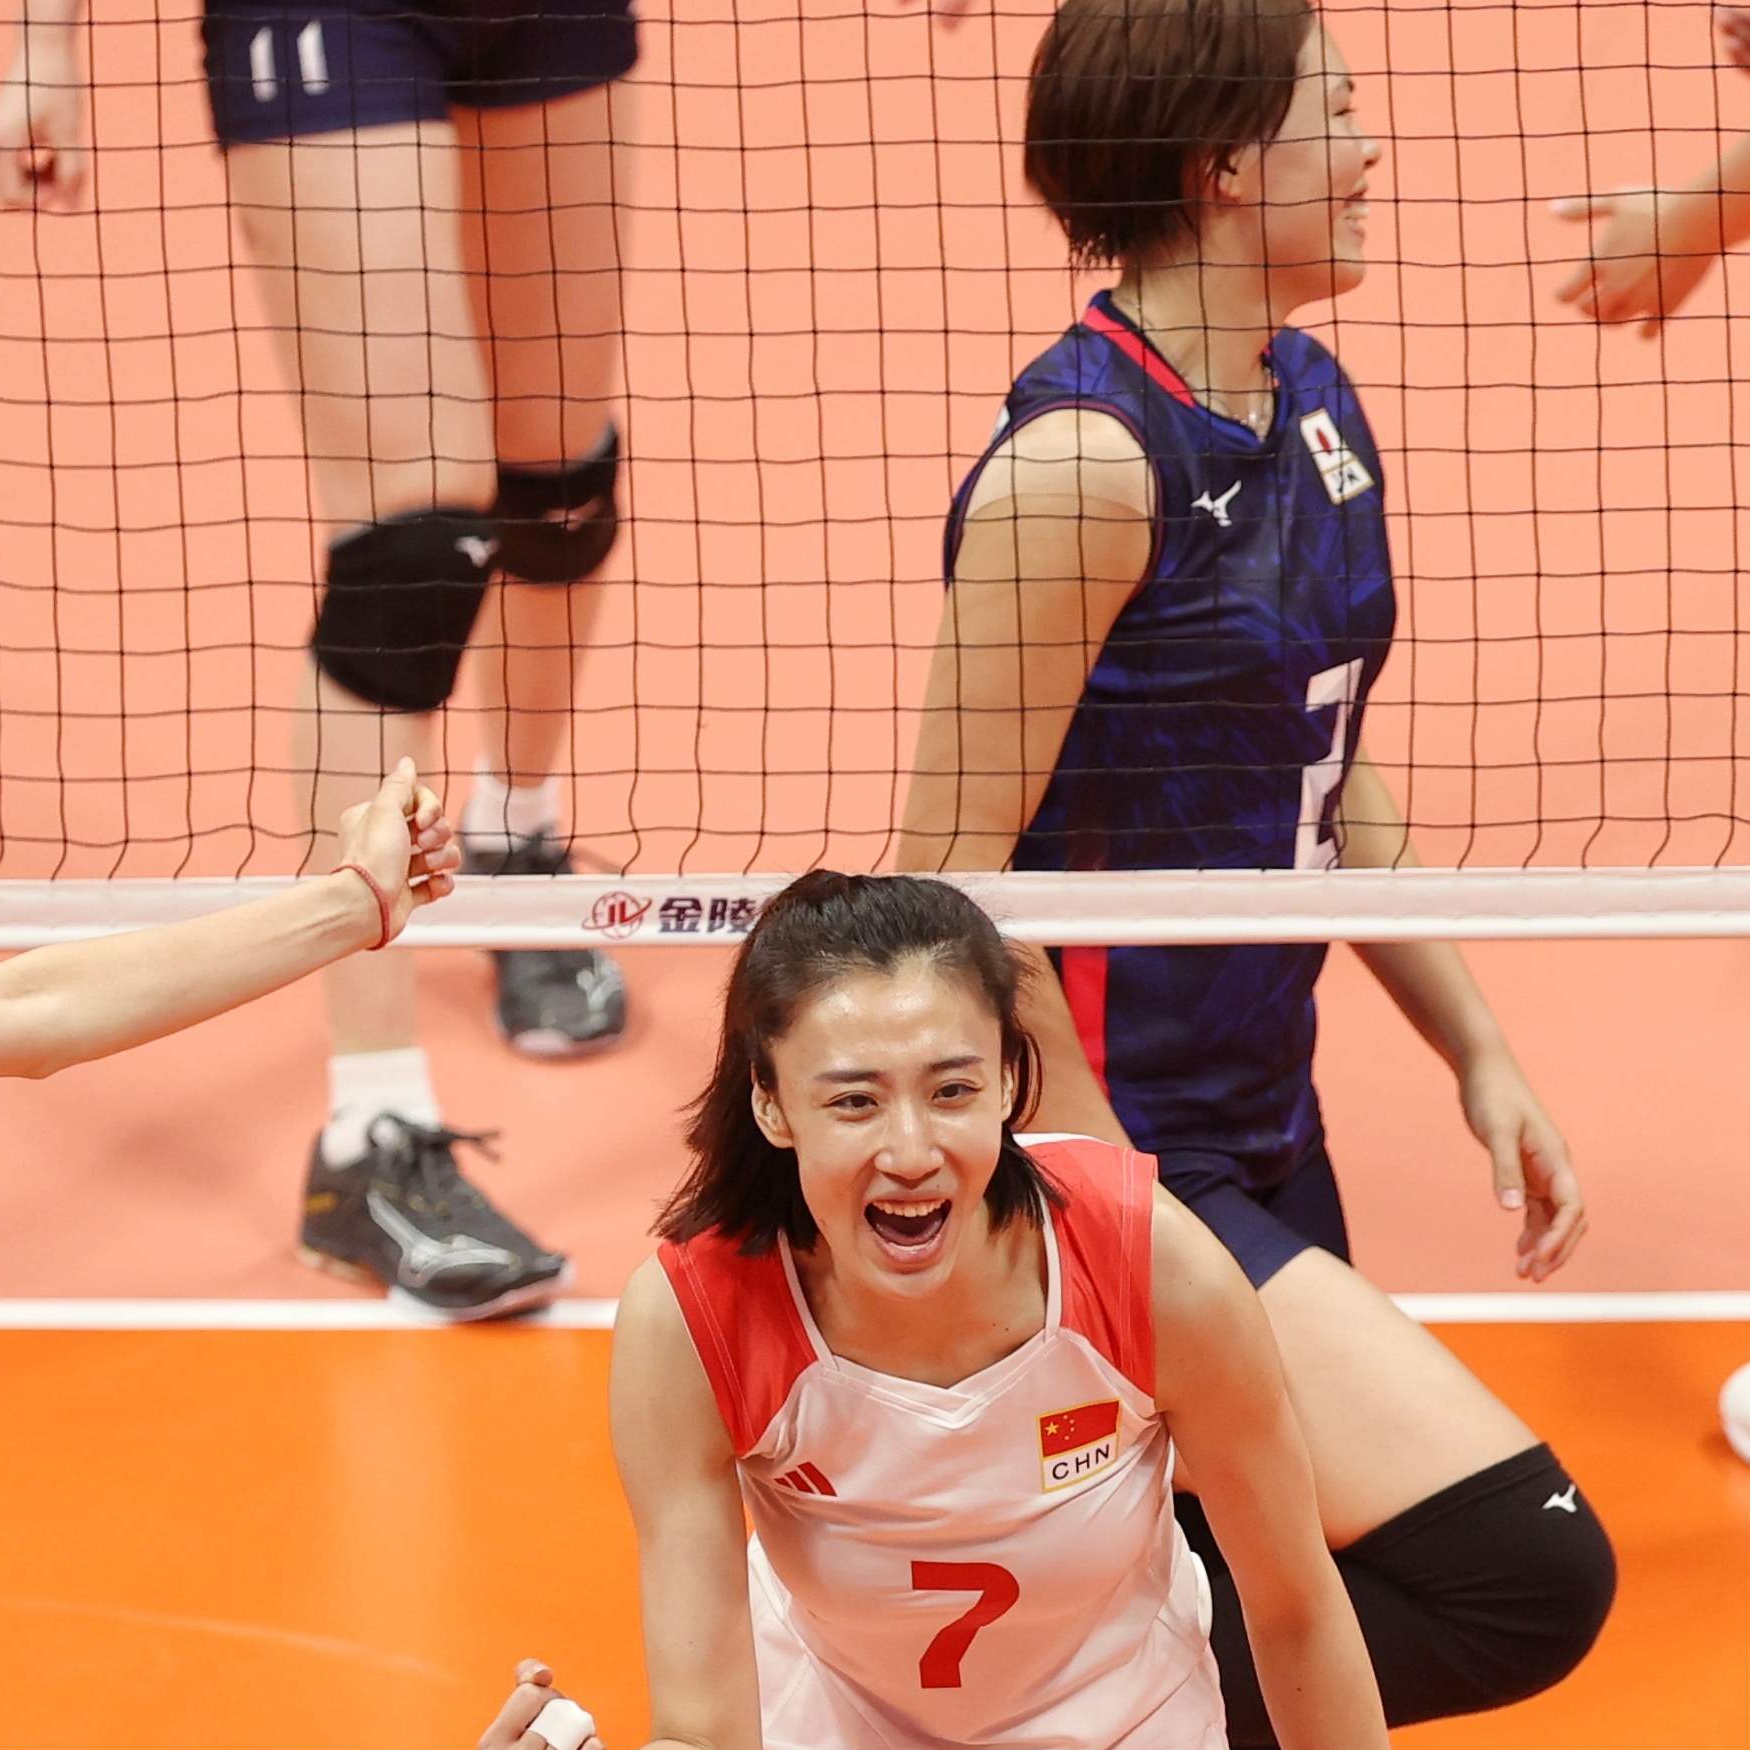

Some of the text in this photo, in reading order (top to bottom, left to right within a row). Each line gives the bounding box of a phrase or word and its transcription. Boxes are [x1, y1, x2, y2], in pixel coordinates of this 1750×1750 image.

[249, 17, 330, 102] 11
[1051, 1443, 1110, 1480] CHN
[910, 1560, 1020, 1689] 7
